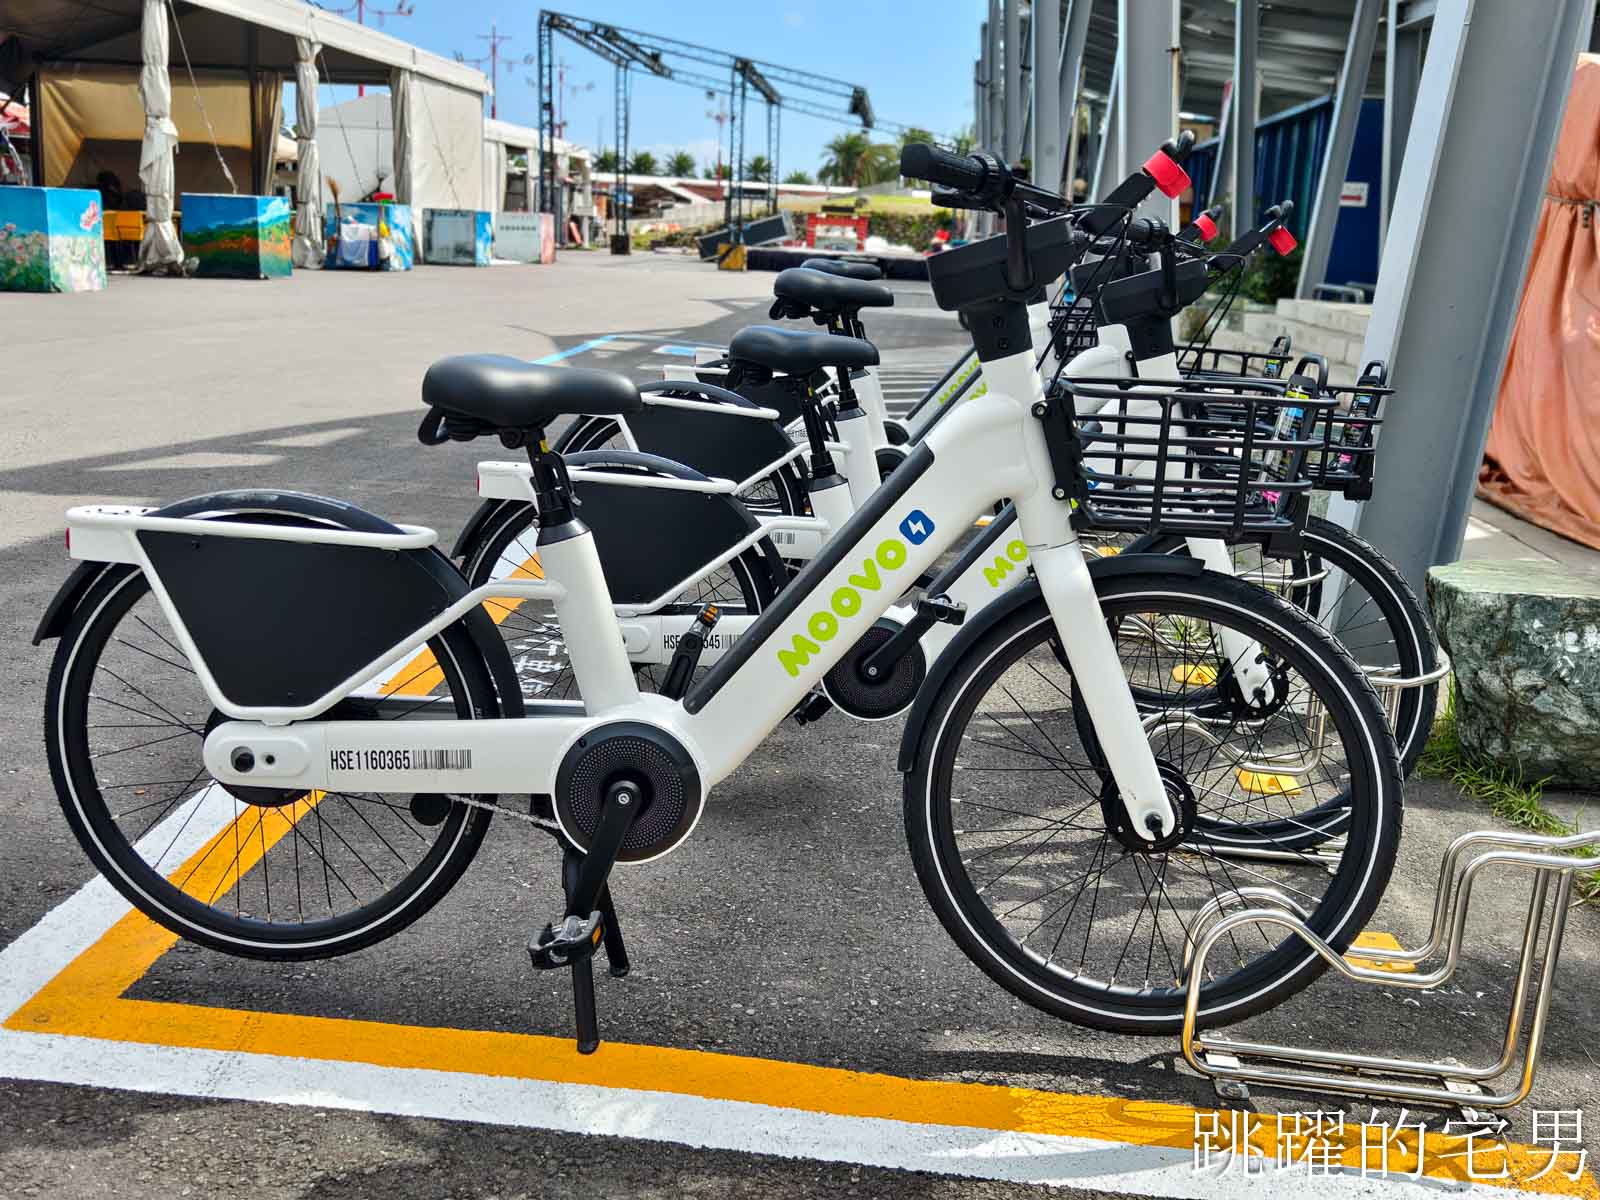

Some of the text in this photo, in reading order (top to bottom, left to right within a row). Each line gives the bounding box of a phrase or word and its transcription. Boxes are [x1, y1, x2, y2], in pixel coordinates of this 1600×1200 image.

[777, 539, 907, 677] MOOVO
[663, 634, 720, 649] HSE545
[330, 750, 411, 770] HSE1160365
